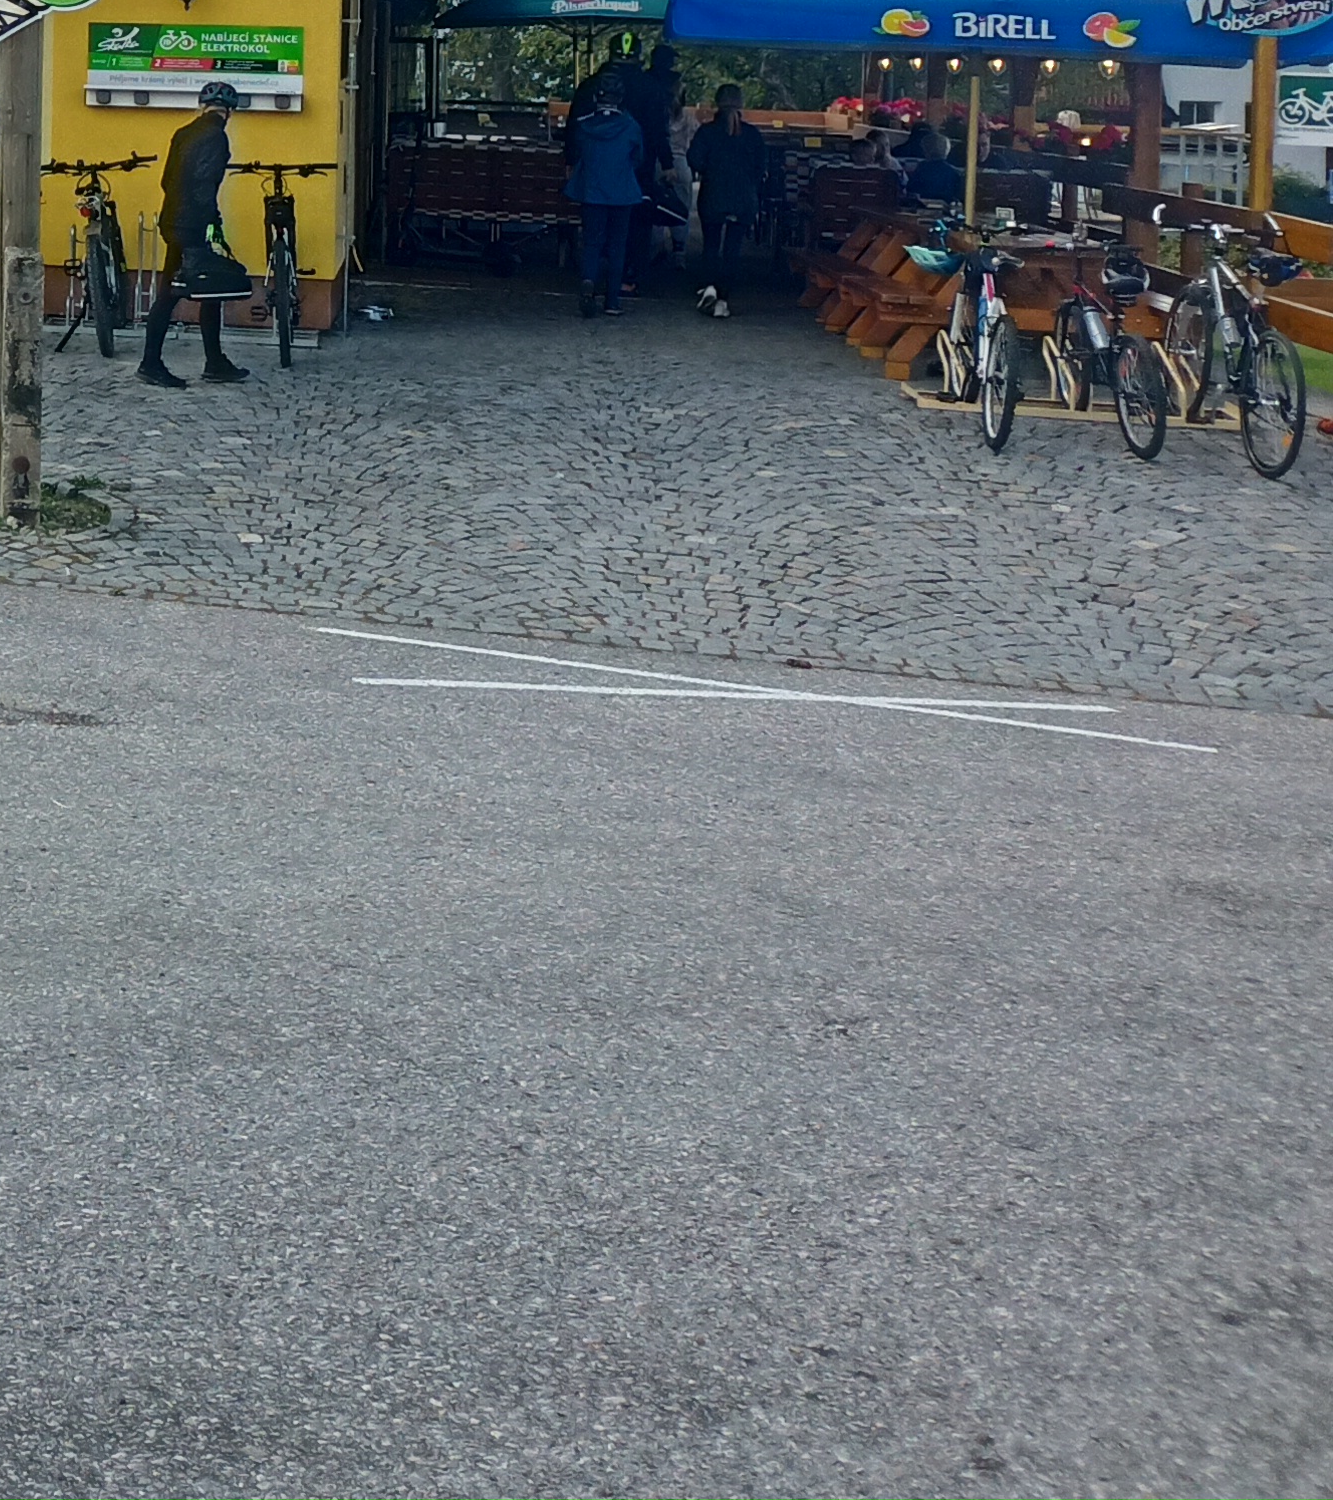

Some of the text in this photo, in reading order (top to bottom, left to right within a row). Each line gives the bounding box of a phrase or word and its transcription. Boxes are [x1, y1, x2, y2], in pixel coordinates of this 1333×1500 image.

[201, 31, 298, 44] NABÍJECÍ STANICE
[201, 43, 270, 53] ELEKTROKOL
